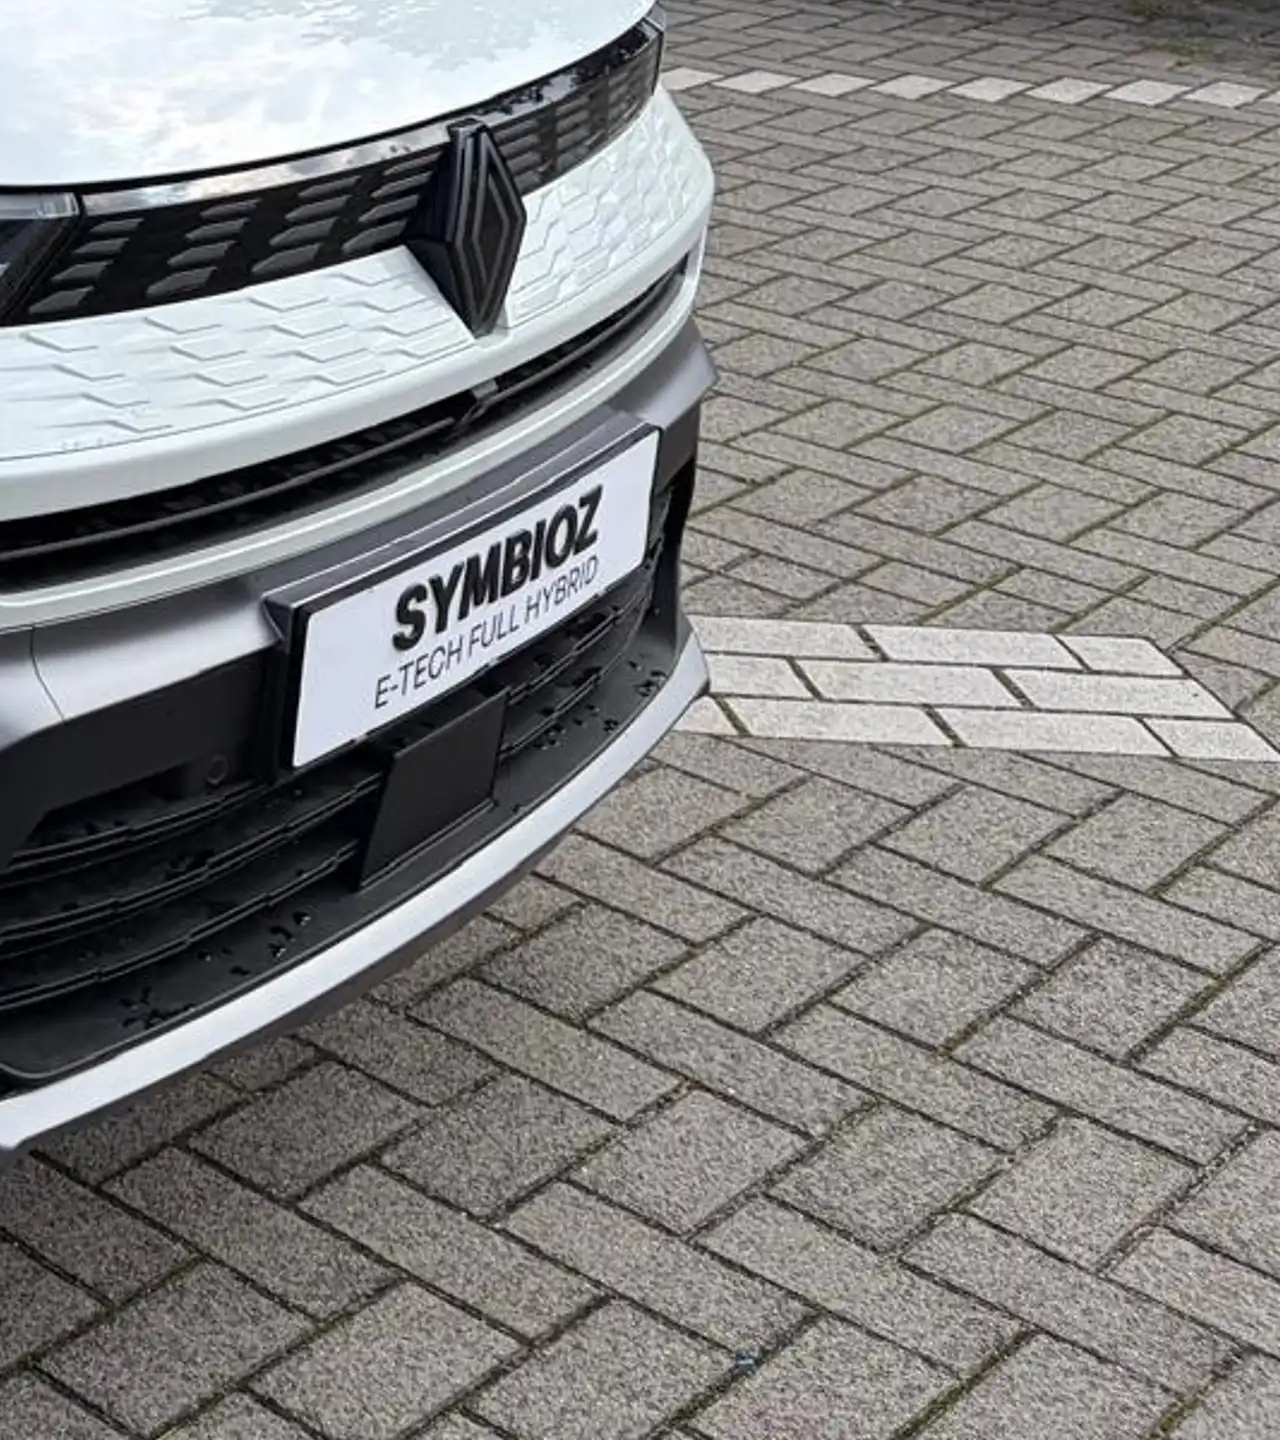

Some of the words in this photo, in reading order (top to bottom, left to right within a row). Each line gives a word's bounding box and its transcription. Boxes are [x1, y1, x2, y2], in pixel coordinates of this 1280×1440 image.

[374, 633, 464, 709] E-TECH
[467, 604, 520, 659] FULL
[524, 555, 598, 625] HYBRID
[392, 484, 603, 652] SYMBIOZ
